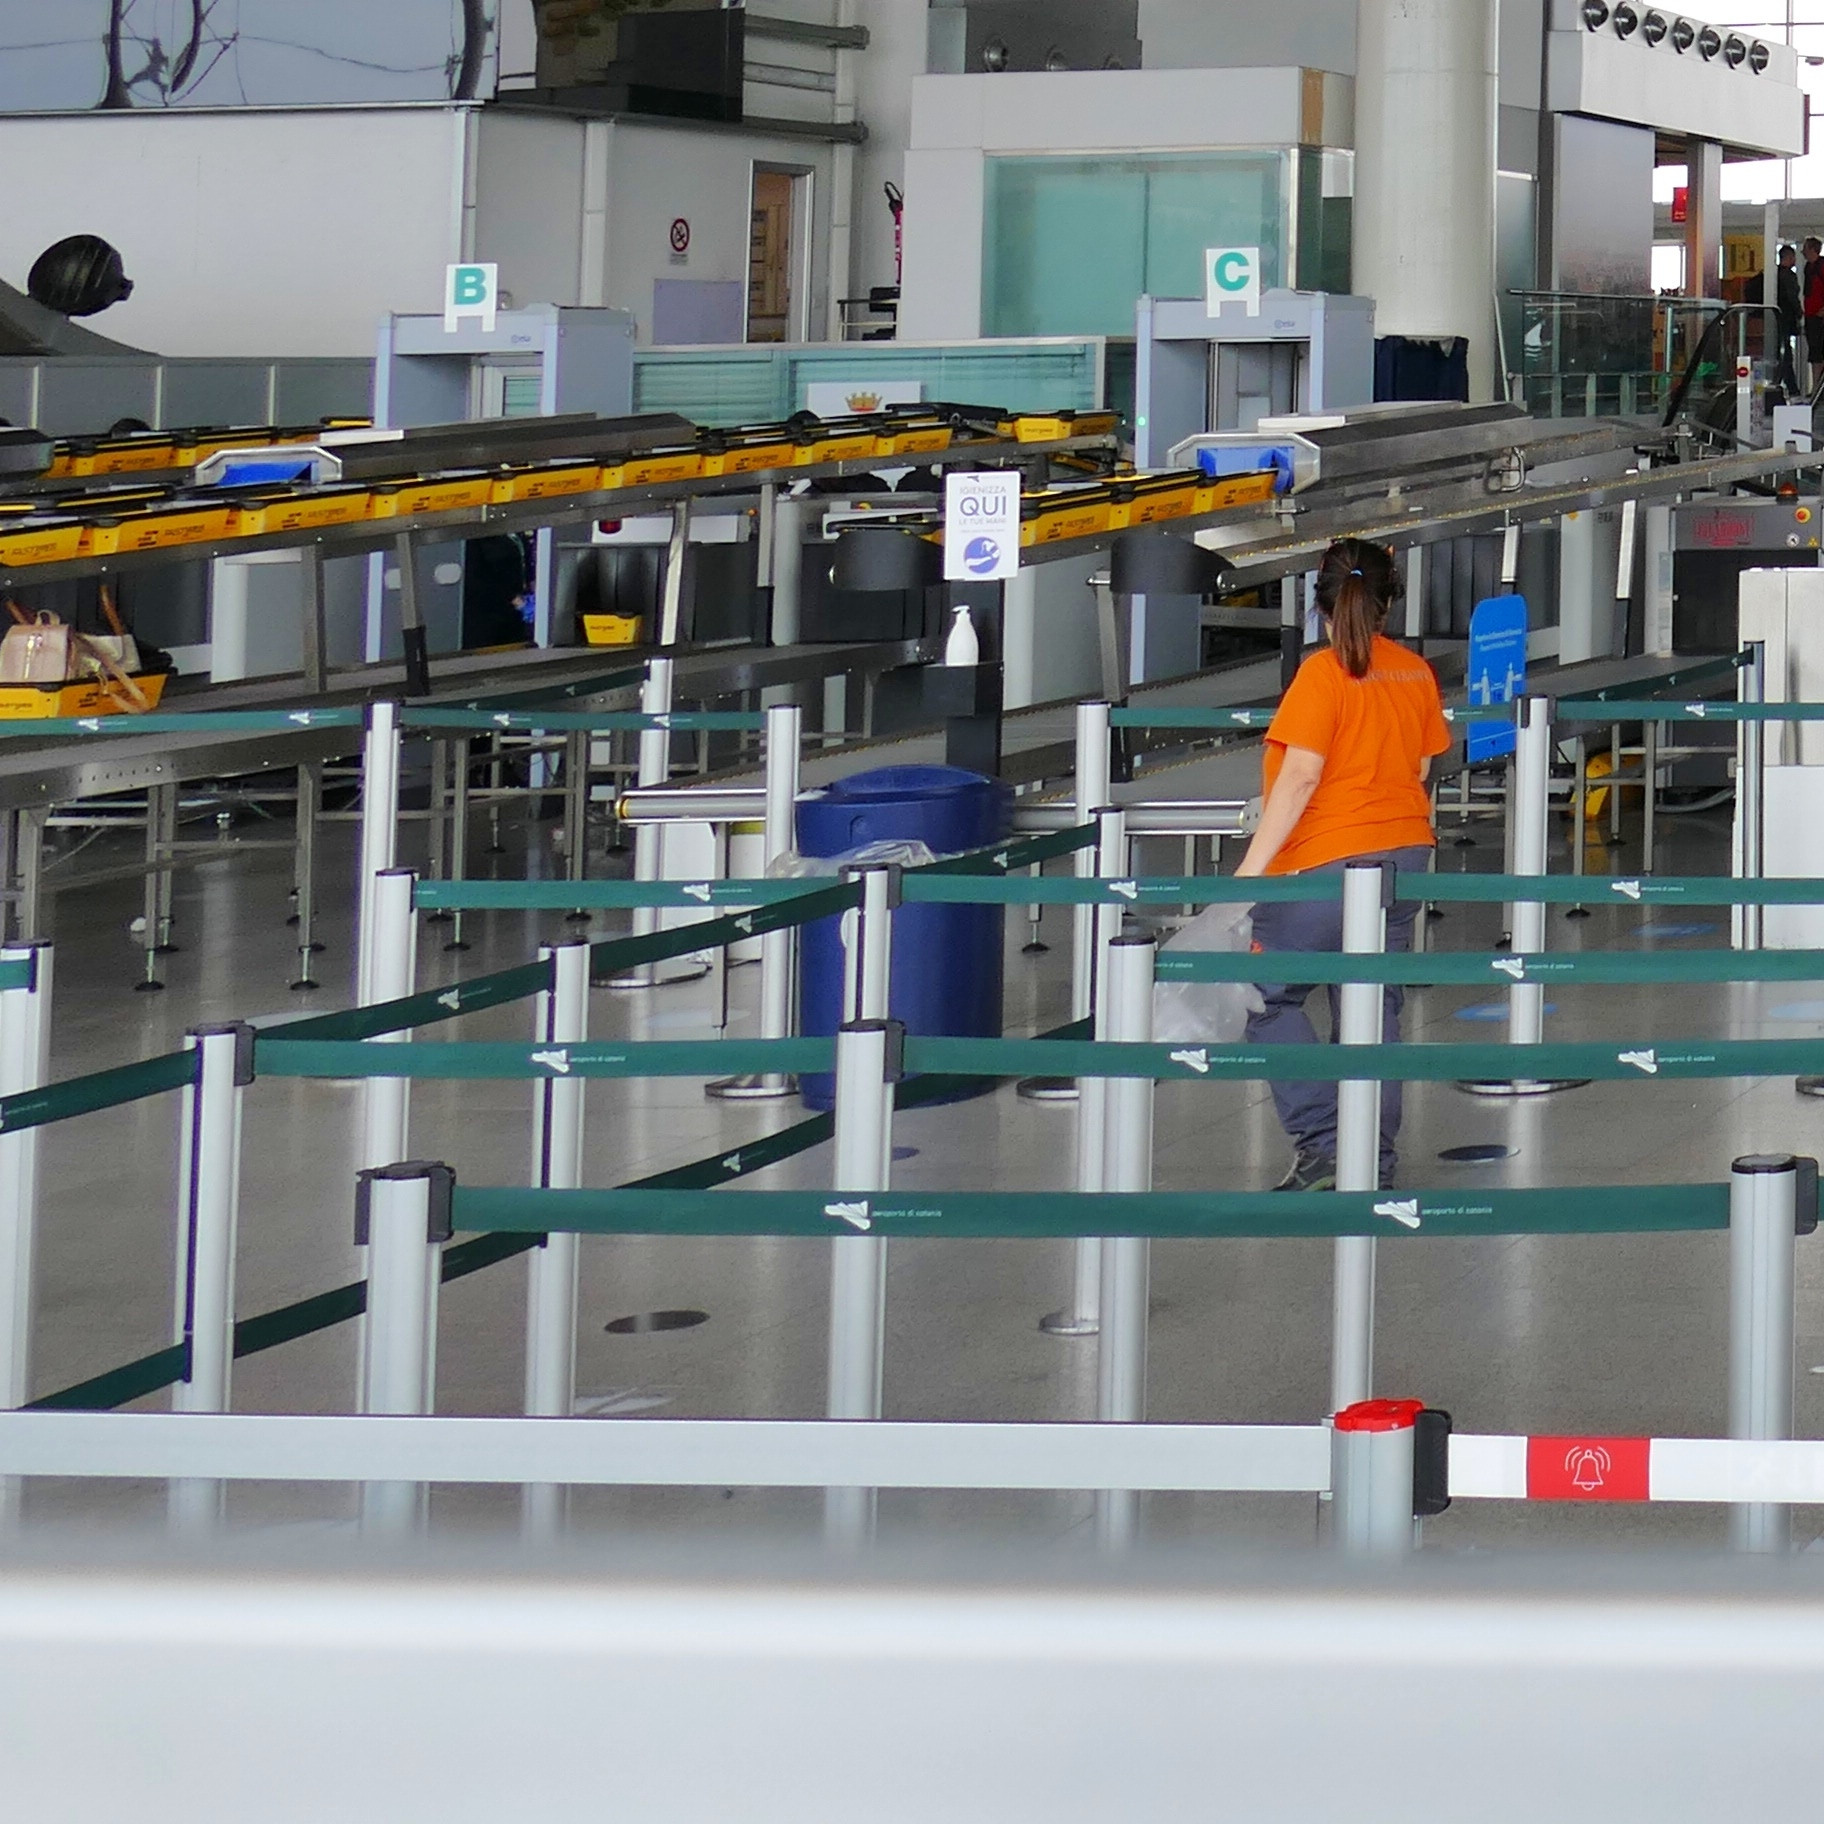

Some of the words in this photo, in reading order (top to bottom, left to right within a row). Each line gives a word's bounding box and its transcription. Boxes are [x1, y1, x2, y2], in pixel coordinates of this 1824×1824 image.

[453, 267, 487, 306] B
[1214, 251, 1250, 292] C
[959, 495, 1007, 517] QUI
